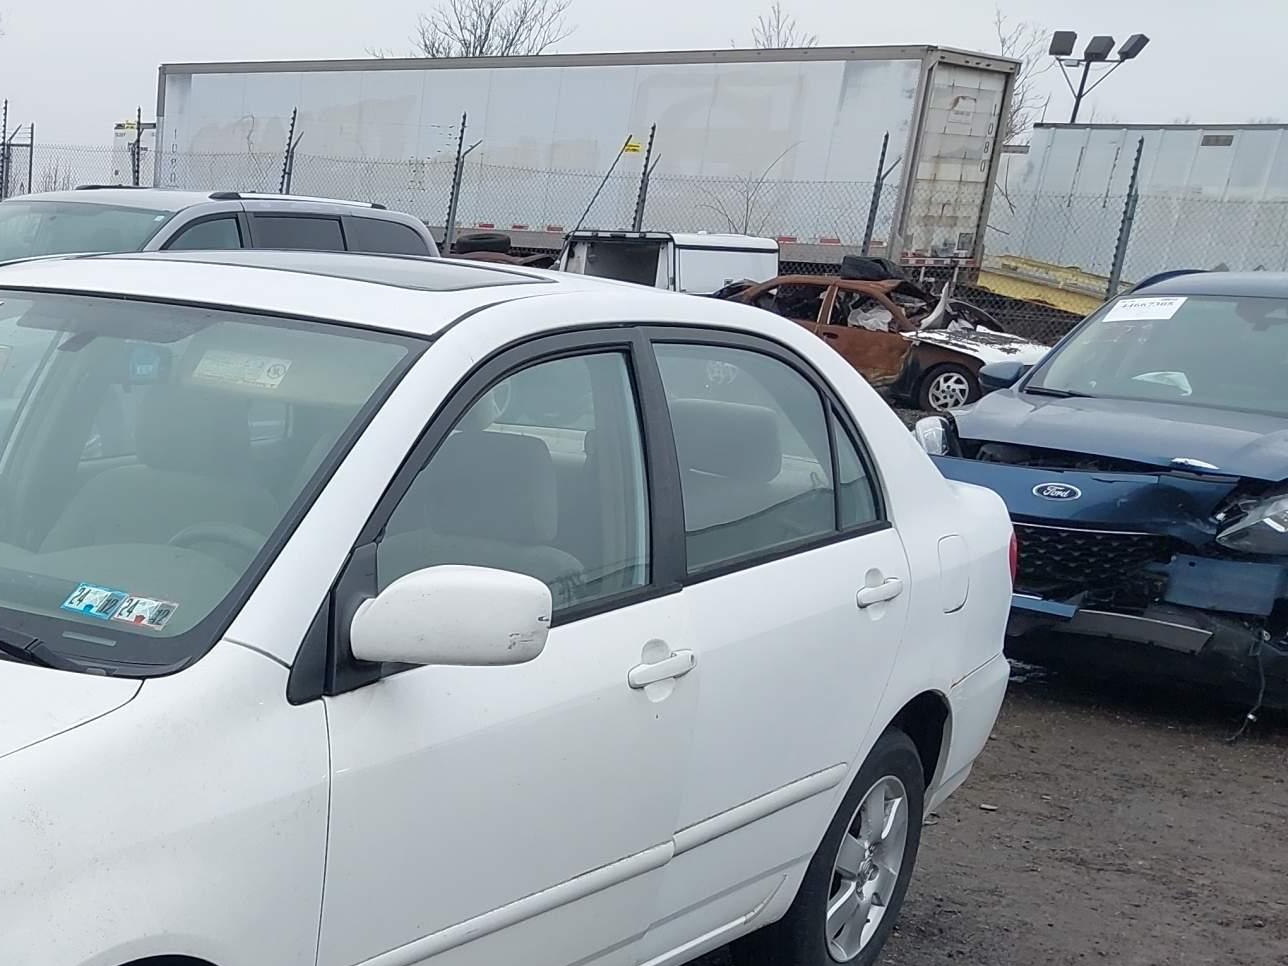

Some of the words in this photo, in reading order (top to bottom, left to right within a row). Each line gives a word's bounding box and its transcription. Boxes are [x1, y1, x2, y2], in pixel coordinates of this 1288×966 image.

[980, 103, 998, 172] 1080
[1042, 485, 1071, 498] Ford
[69, 587, 91, 607] 24
[118, 598, 139, 617] 24
